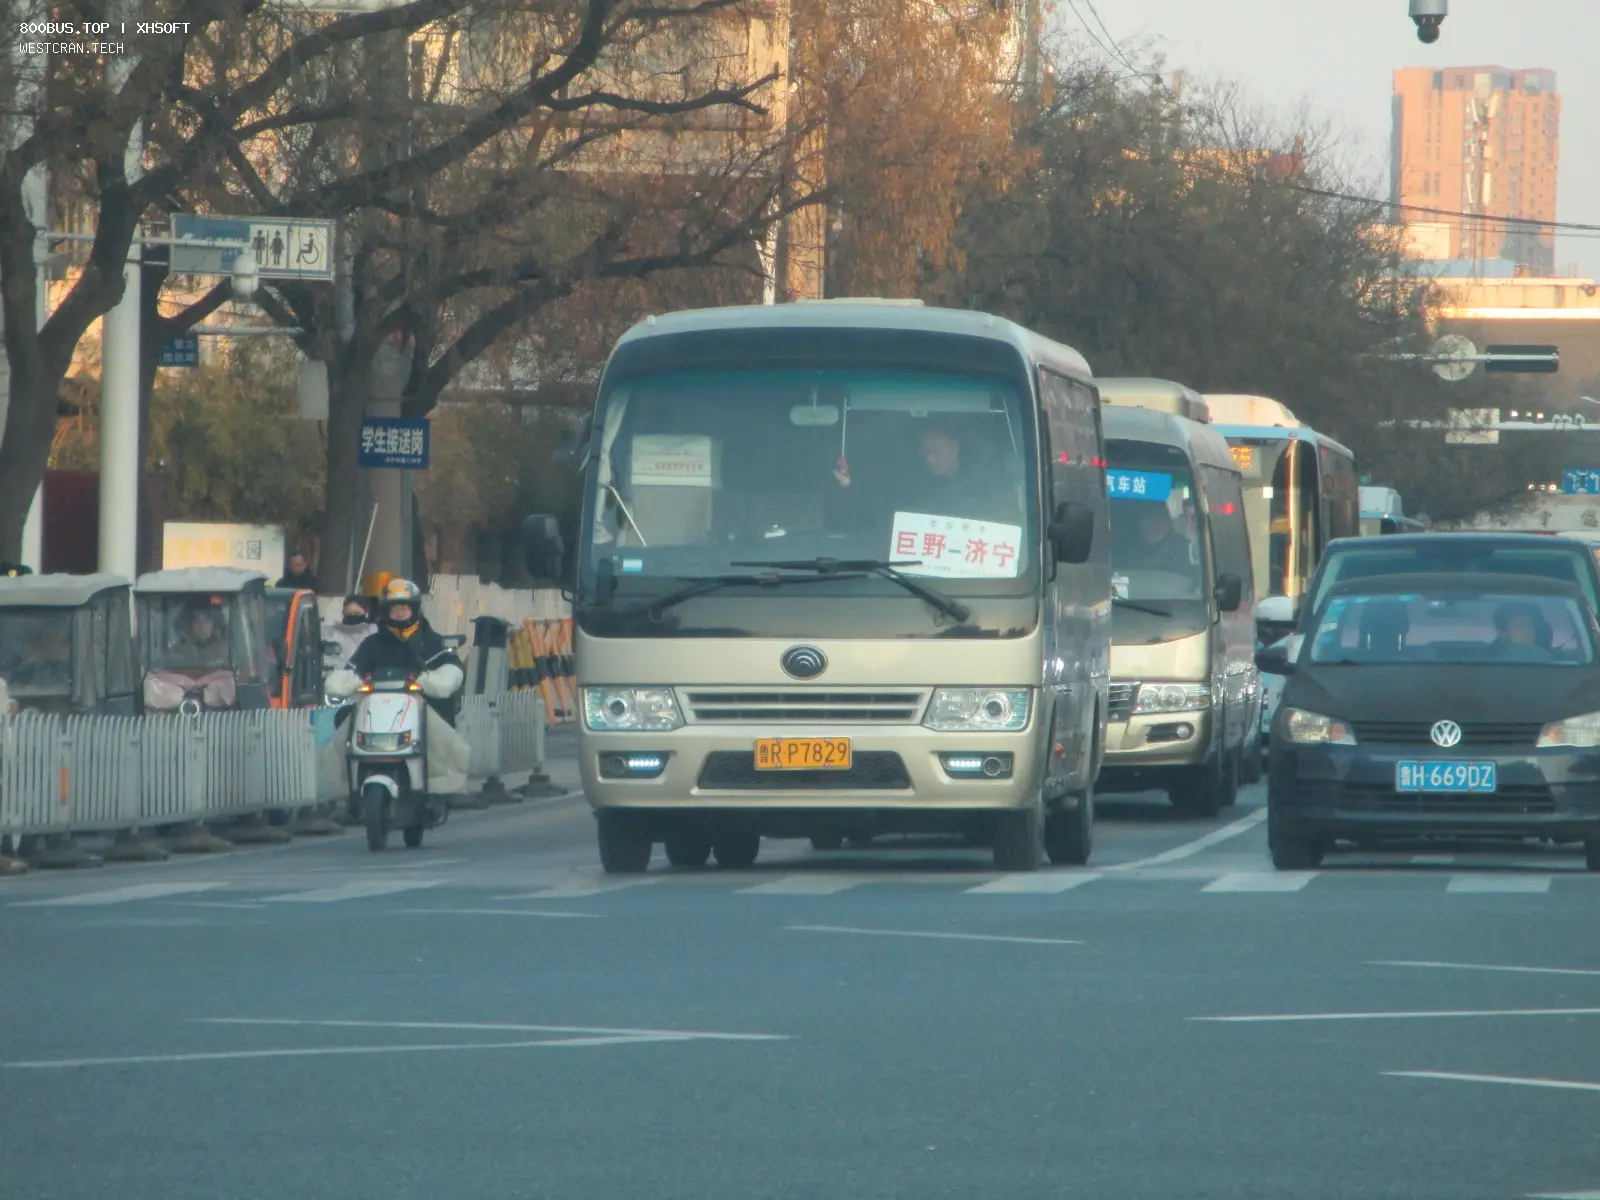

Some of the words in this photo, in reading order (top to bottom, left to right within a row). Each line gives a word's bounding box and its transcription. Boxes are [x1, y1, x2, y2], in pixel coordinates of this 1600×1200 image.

[362, 426, 423, 455] 学生接送岗
